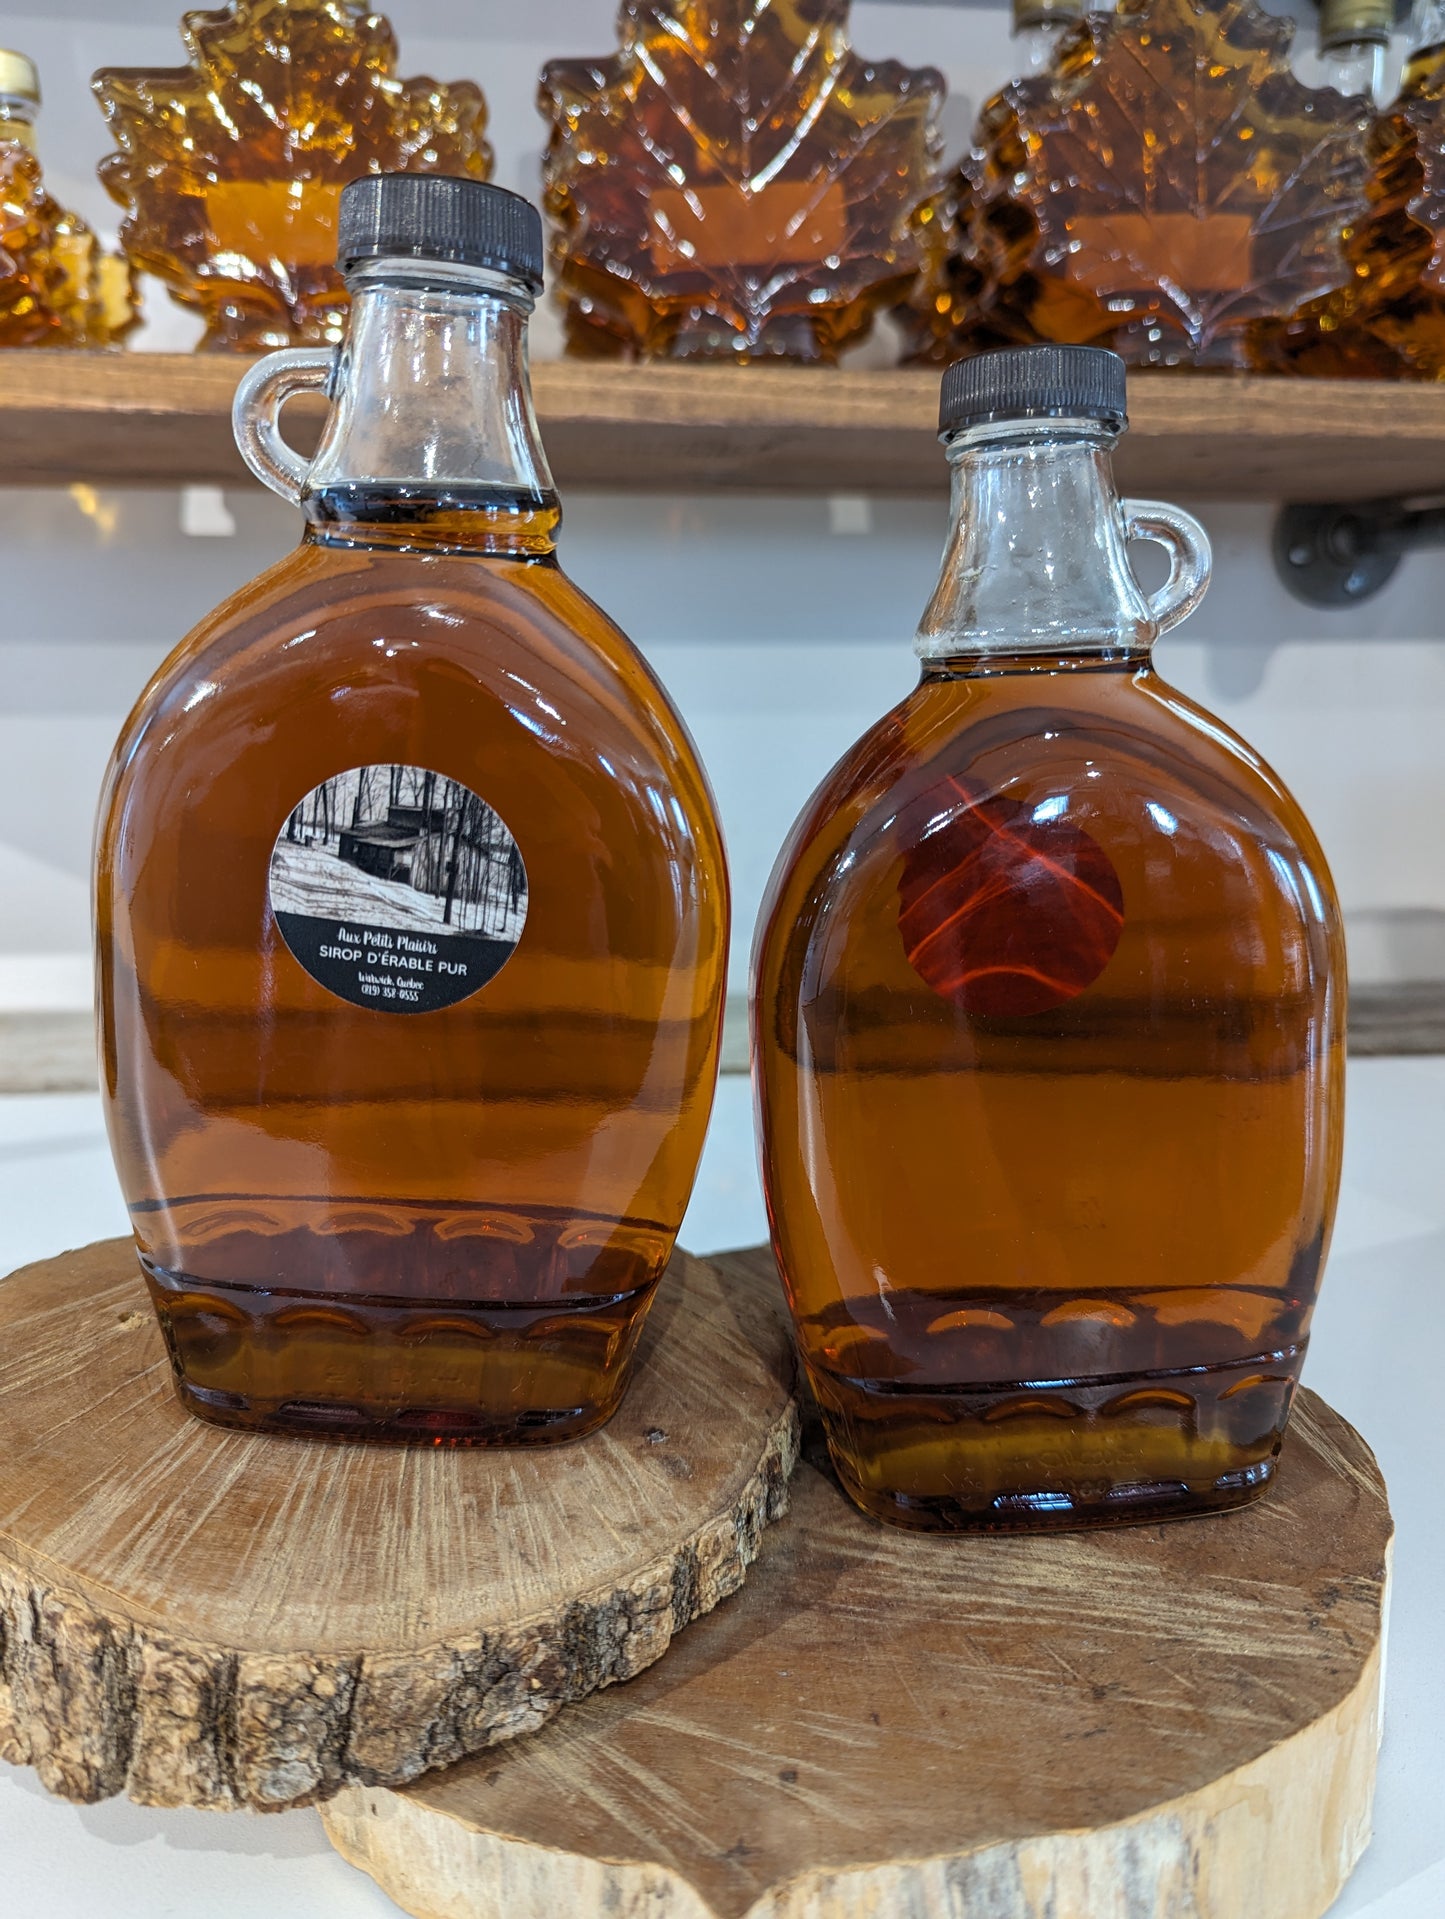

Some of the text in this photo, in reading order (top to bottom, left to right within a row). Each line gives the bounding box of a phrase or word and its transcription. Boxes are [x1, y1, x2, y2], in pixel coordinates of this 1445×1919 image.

[337, 927, 439, 954] Aux Petits Plaisirs
[319, 945, 467, 976] SIROP D'ÉRABLE PUR
